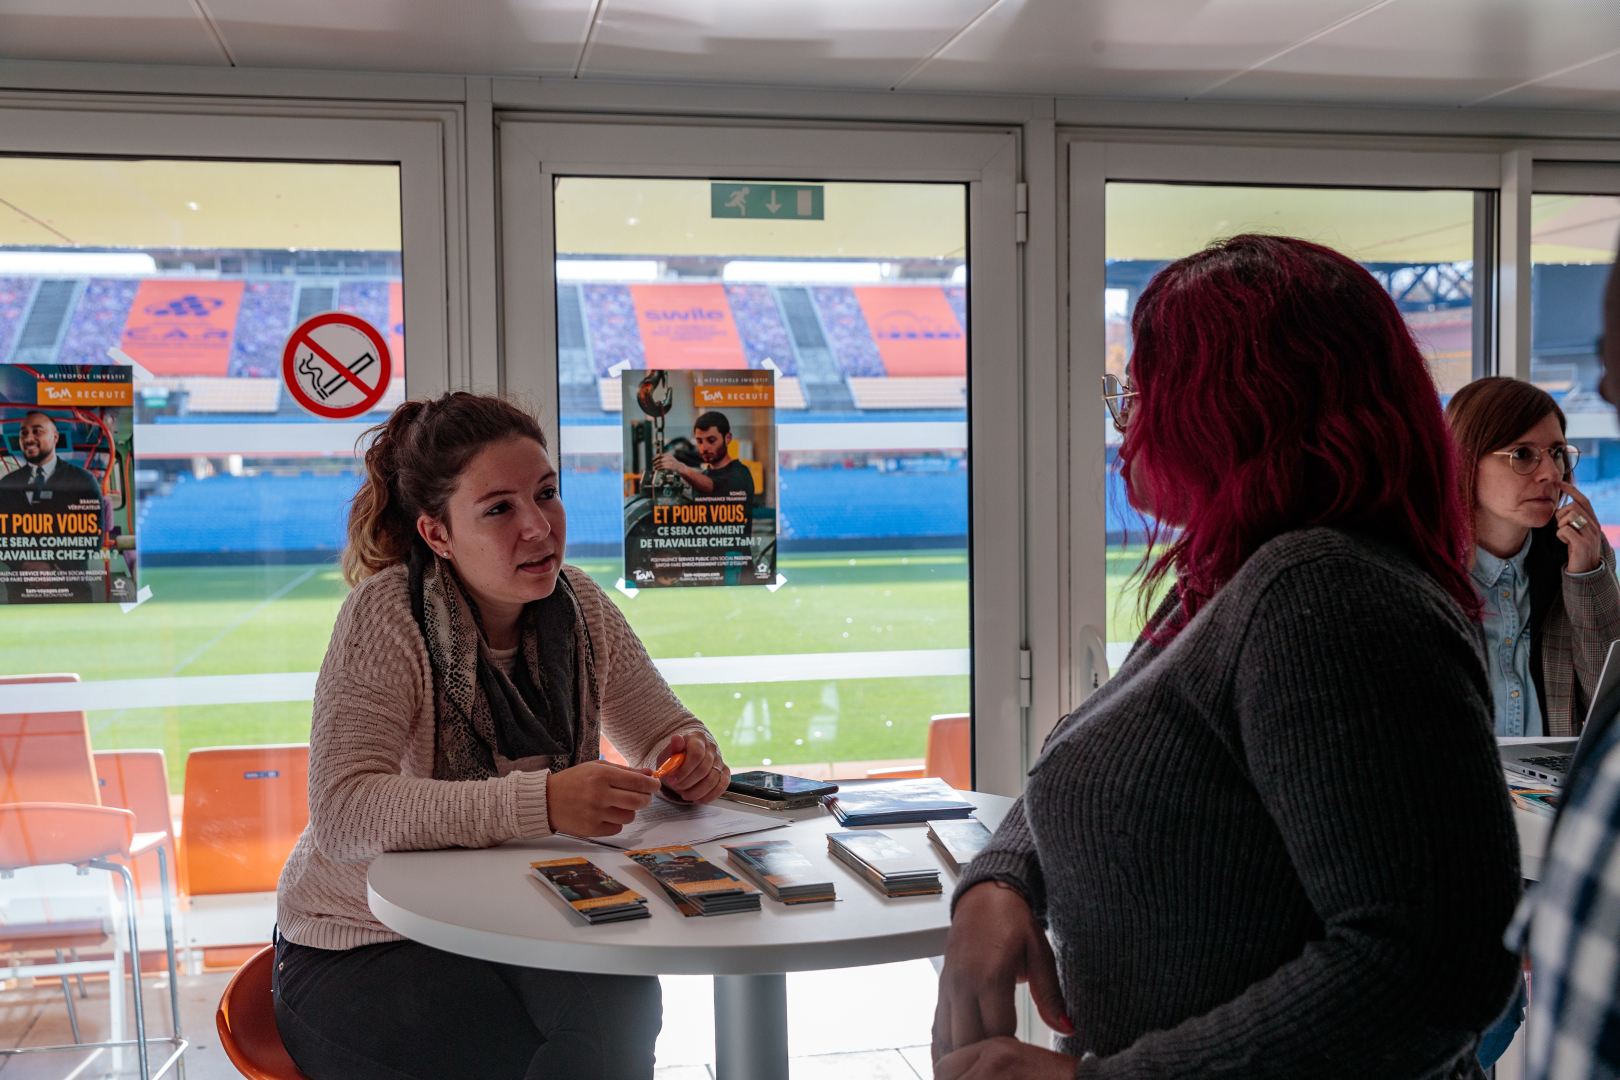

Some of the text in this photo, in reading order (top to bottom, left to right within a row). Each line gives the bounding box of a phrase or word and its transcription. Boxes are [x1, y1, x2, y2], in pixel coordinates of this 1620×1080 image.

[48, 372, 90, 380] MÉTROPOLE
[77, 390, 125, 399] RECRUTE
[653, 504, 748, 524] ET POUR VOUS,
[12, 513, 54, 534] POUR
[57, 513, 102, 536] VOUS,
[657, 525, 745, 536] CE SERA COMMENT
[10, 536, 38, 547] SERA
[40, 536, 99, 547] COMMENT
[640, 538, 652, 548] DE
[653, 538, 708, 548] TRAVAILLER
[709, 537, 734, 547] CHEZ
[735, 537, 755, 546] TaM
[0, 549, 119, 561] RAVAILLER CHEZ TaM ?
